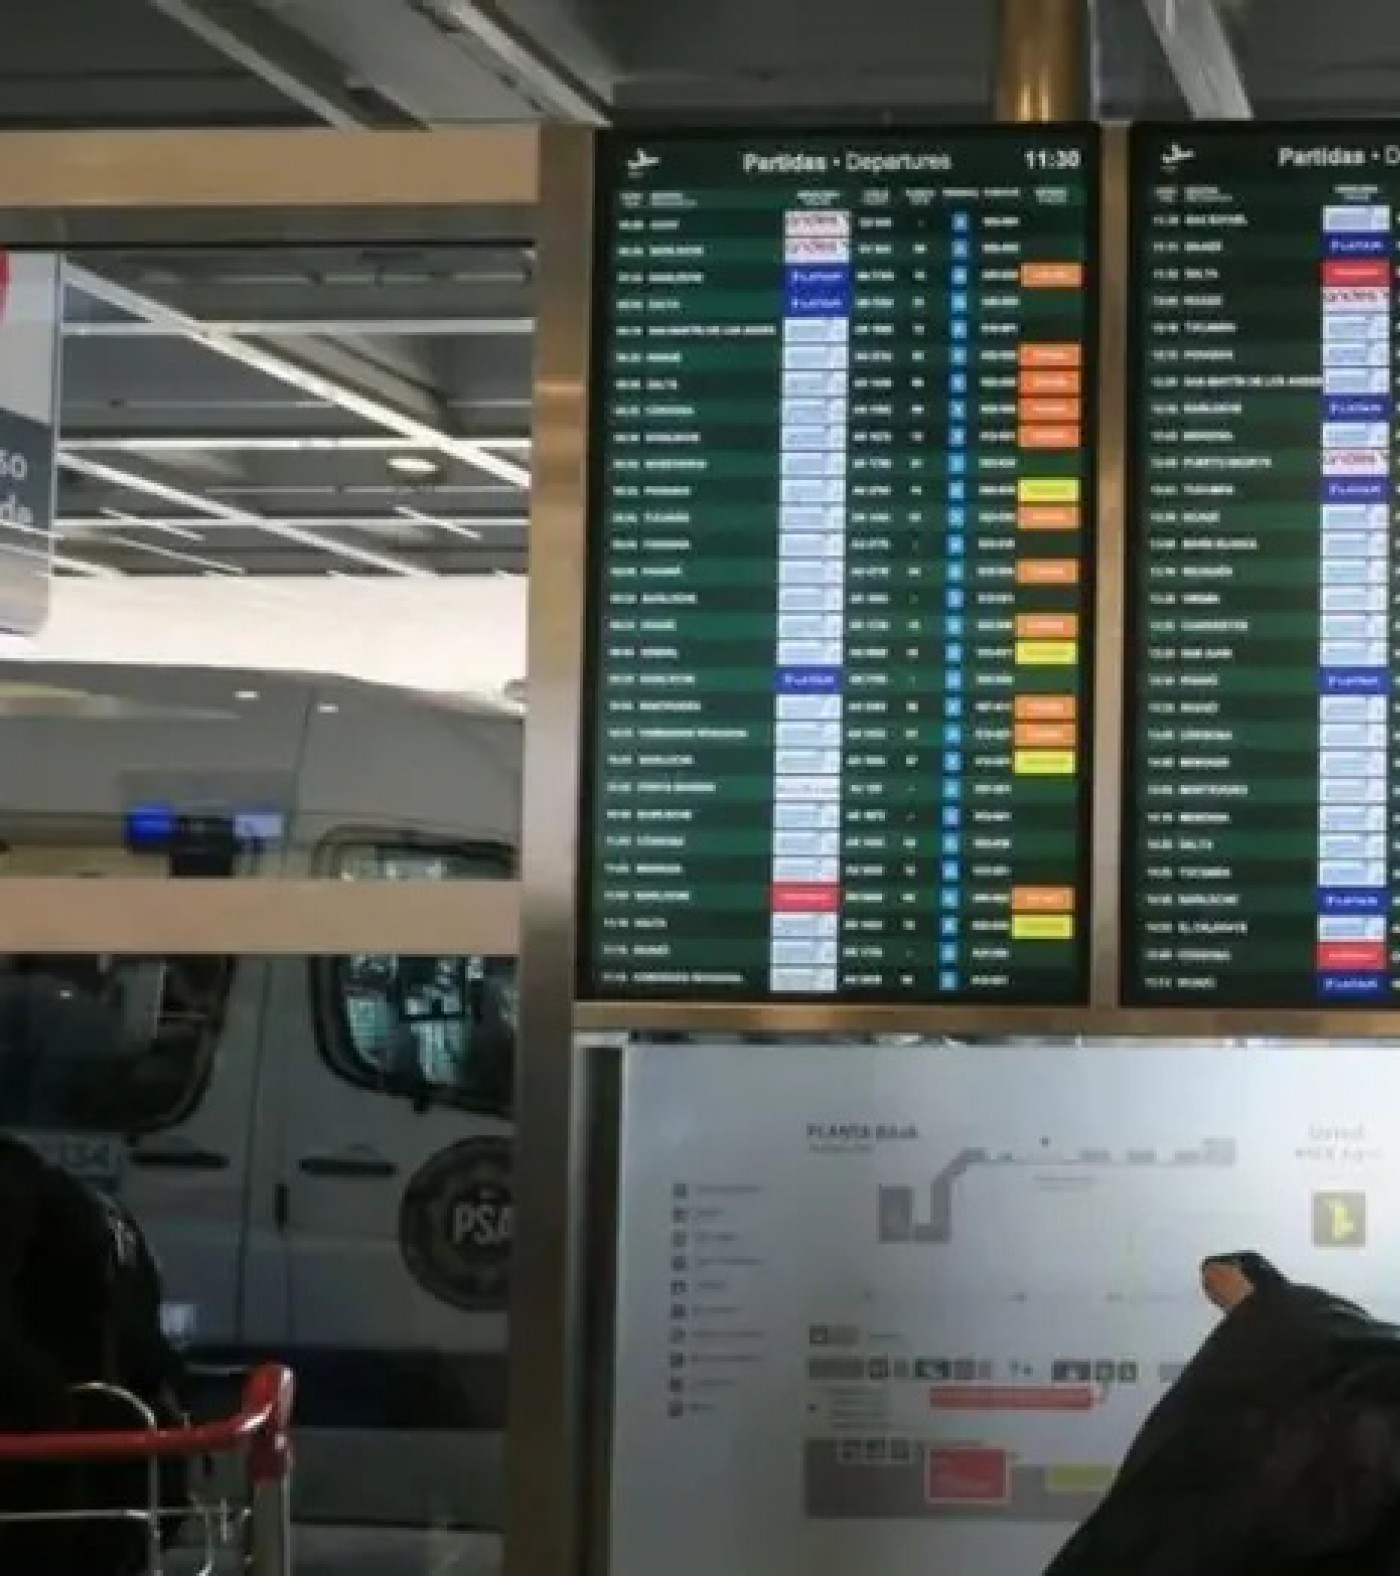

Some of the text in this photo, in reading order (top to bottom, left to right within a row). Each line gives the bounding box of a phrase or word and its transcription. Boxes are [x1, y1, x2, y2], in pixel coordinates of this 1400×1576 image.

[743, 153, 952, 175] Partidas Departures
[1024, 149, 1082, 169] 11:30
[1278, 146, 1366, 166] Partidas
